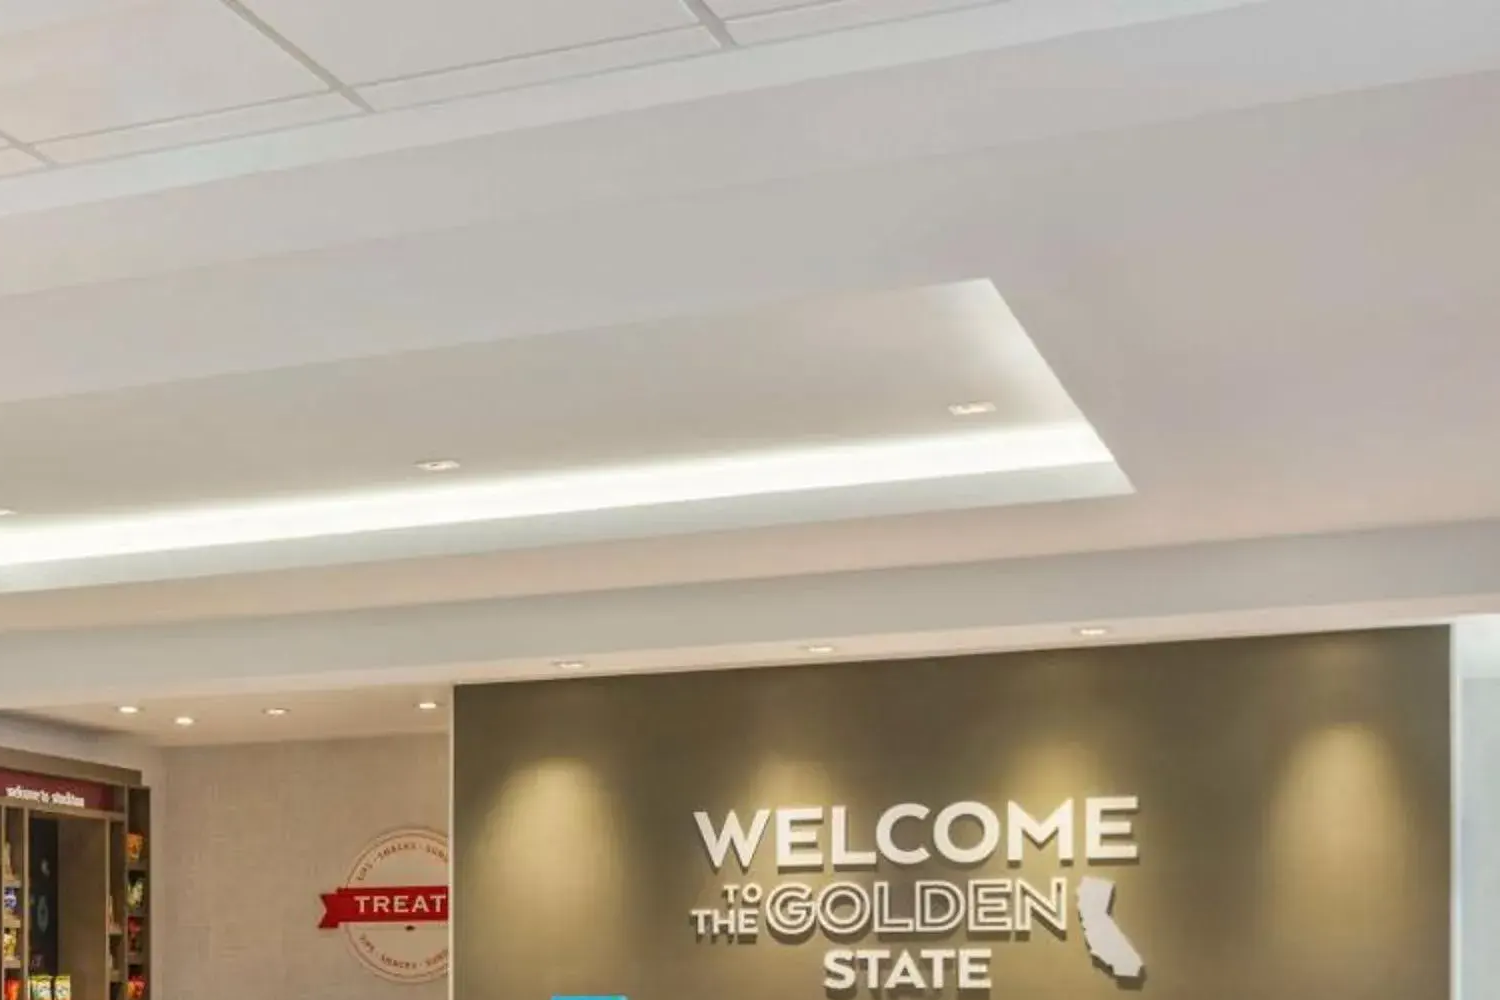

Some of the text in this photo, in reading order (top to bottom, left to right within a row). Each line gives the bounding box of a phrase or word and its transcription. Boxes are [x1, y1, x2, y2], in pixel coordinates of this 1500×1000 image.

[693, 796, 1138, 869] WELCOME
[353, 894, 447, 914] TREAT
[689, 876, 1068, 936] THE GOLDEN
[722, 882, 763, 905] TO
[823, 947, 993, 990] STATE
